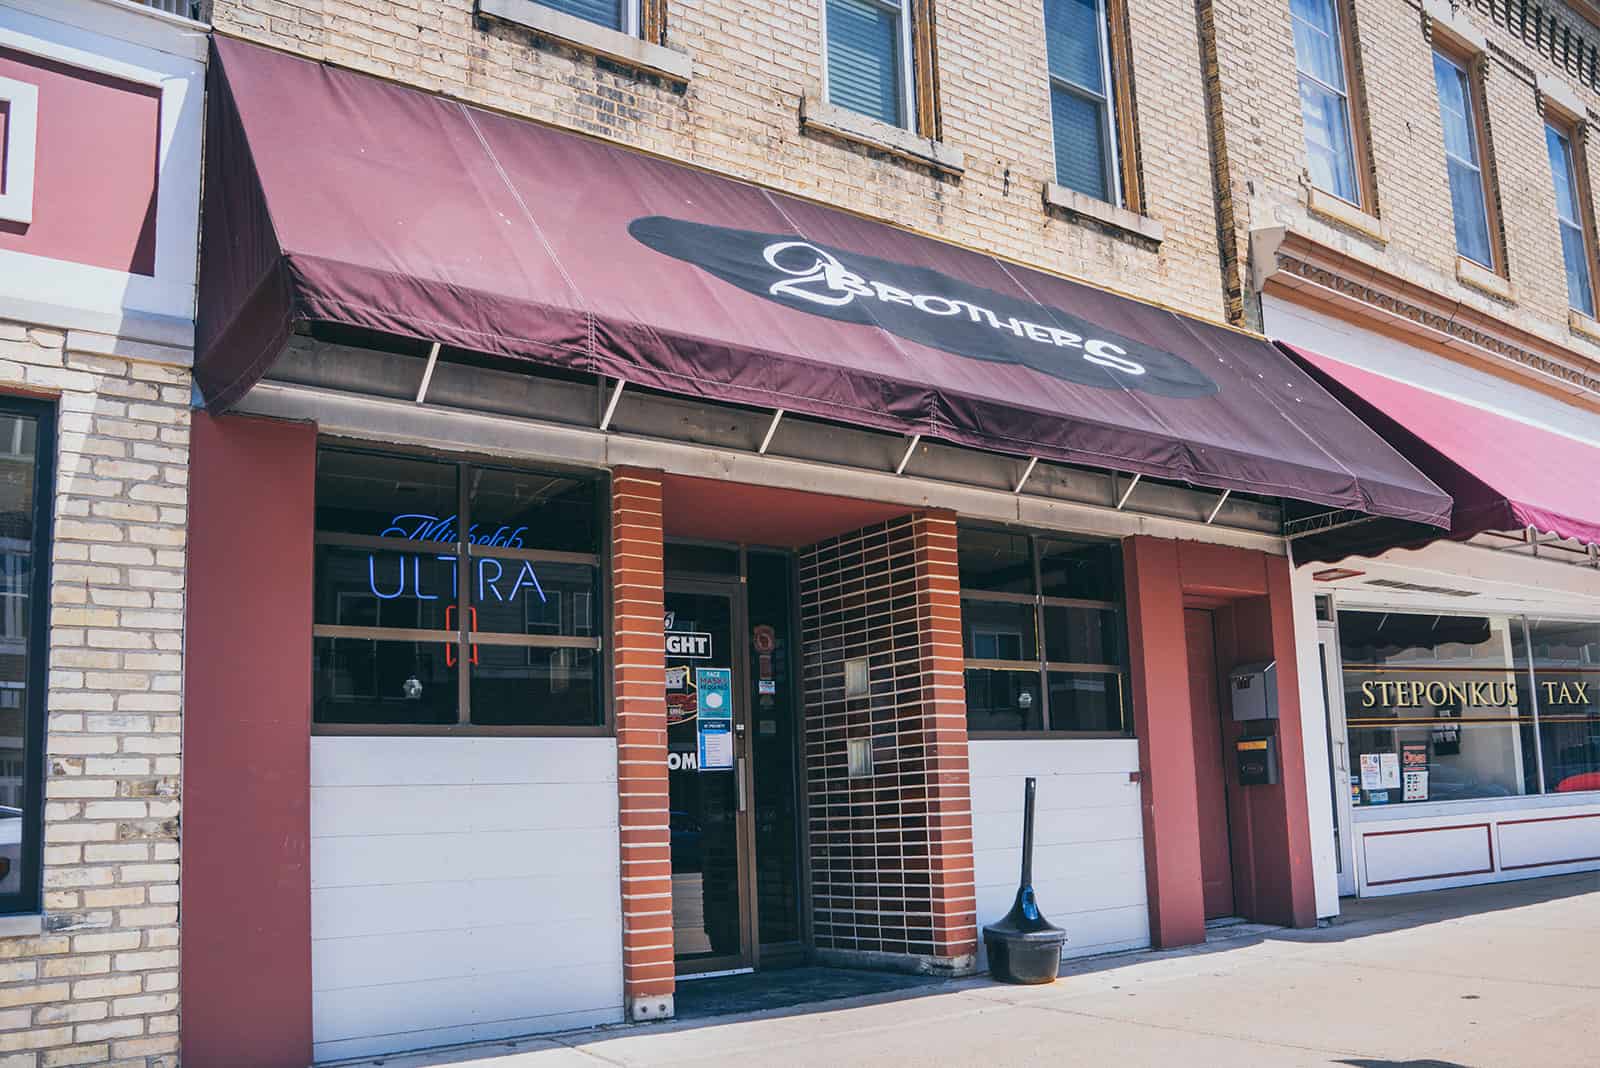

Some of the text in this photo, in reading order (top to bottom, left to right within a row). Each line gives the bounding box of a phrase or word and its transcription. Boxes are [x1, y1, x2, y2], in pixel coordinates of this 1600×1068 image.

[824, 259, 1146, 376] BROTHERS
[369, 554, 547, 602] ULTRA
[1361, 680, 1590, 707] STEPONKUS TAX
